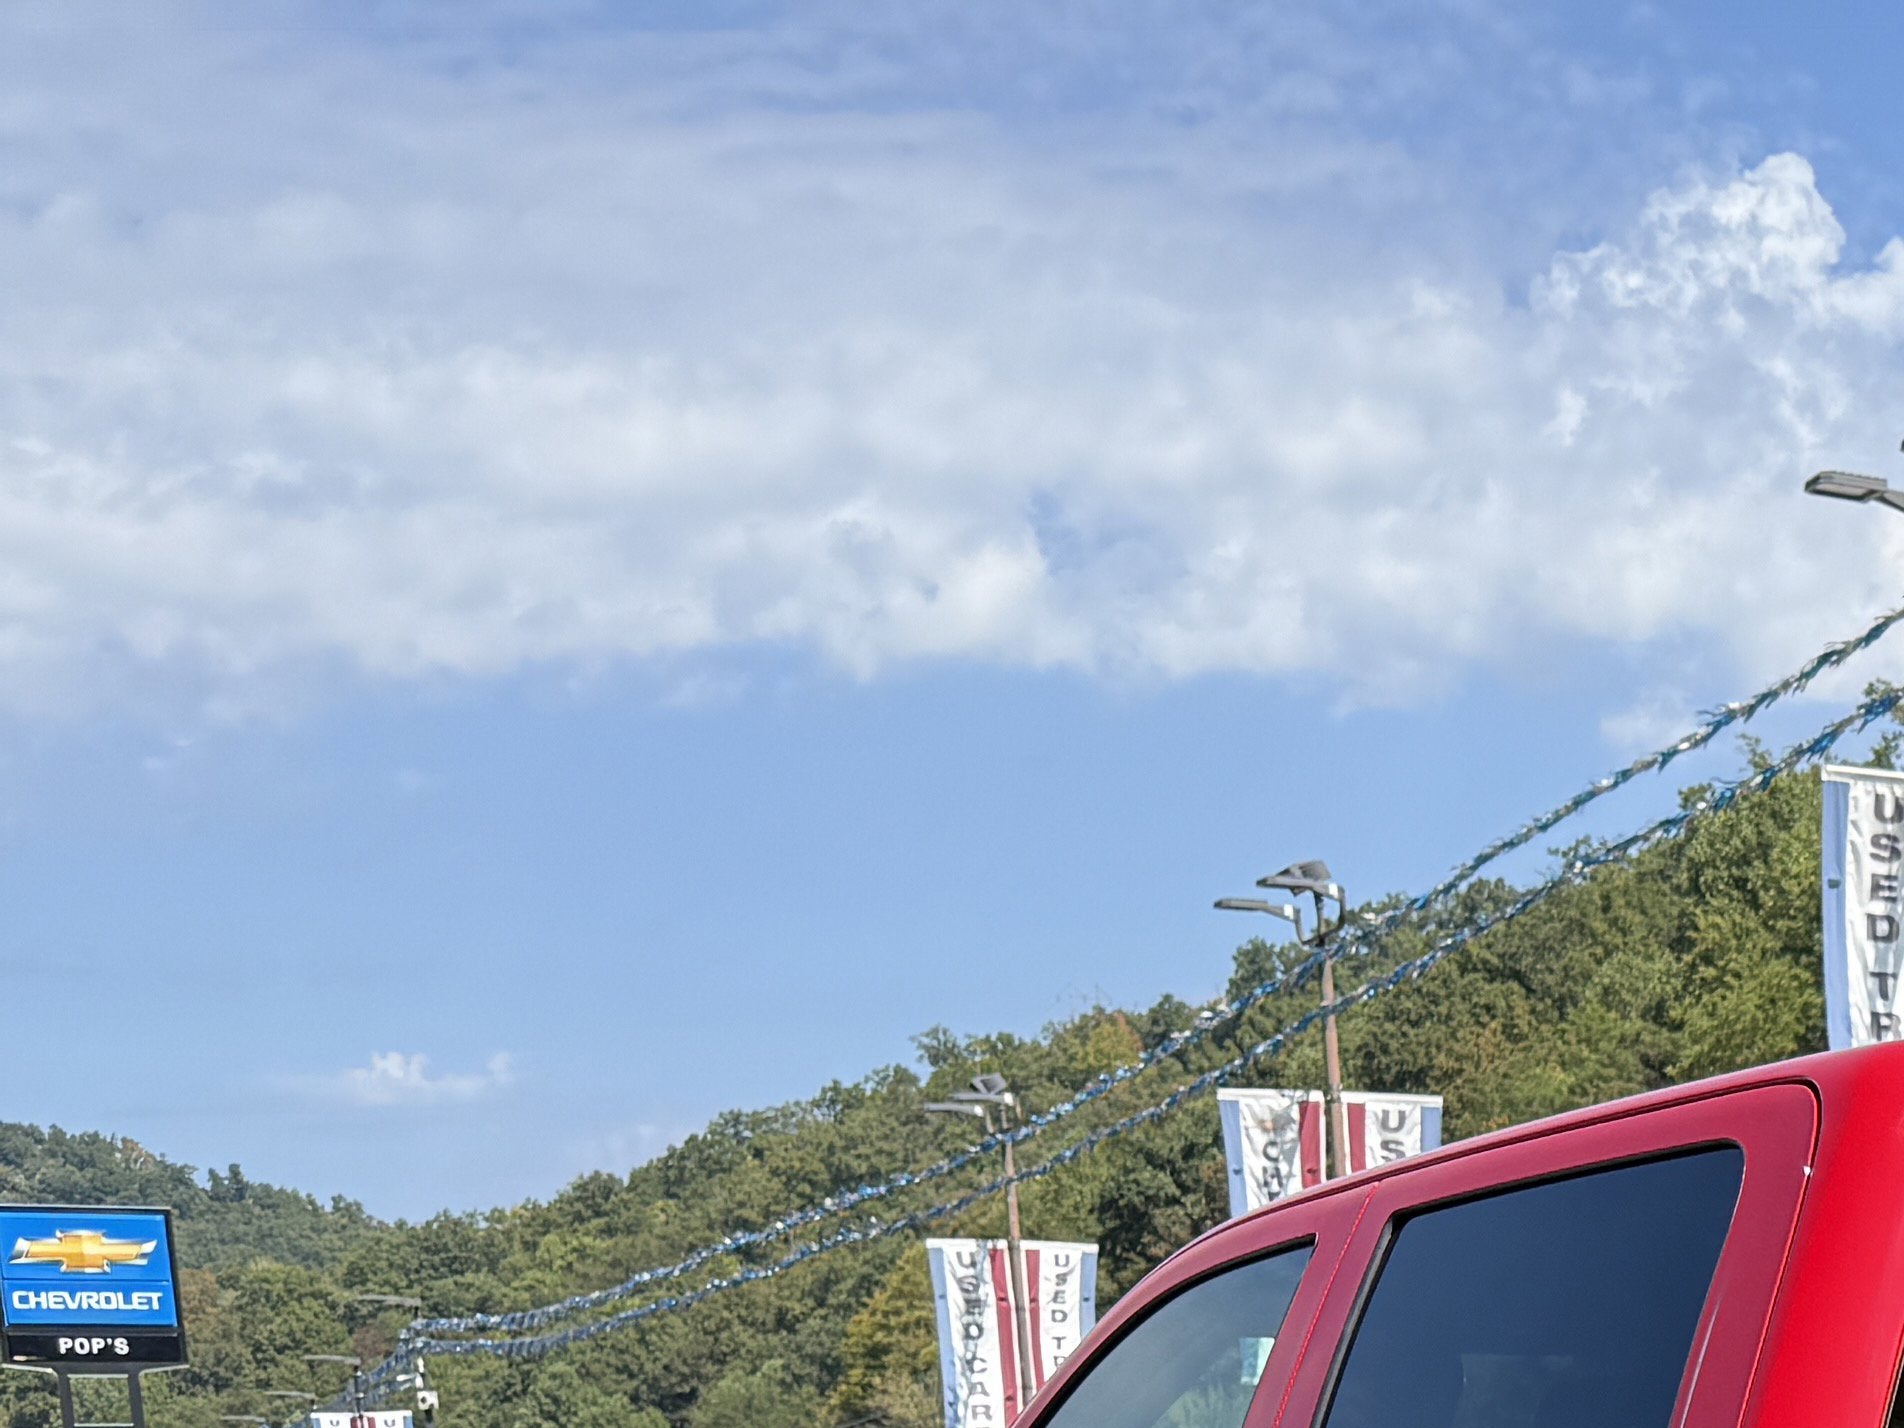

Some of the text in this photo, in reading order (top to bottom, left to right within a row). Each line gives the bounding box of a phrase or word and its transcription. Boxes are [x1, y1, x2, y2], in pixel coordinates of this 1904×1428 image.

[1866, 793, 1904, 944] USED
[12, 1290, 163, 1311] CHEVROLET
[1050, 1254, 1070, 1323] USED
[58, 1337, 130, 1355] POP'S
